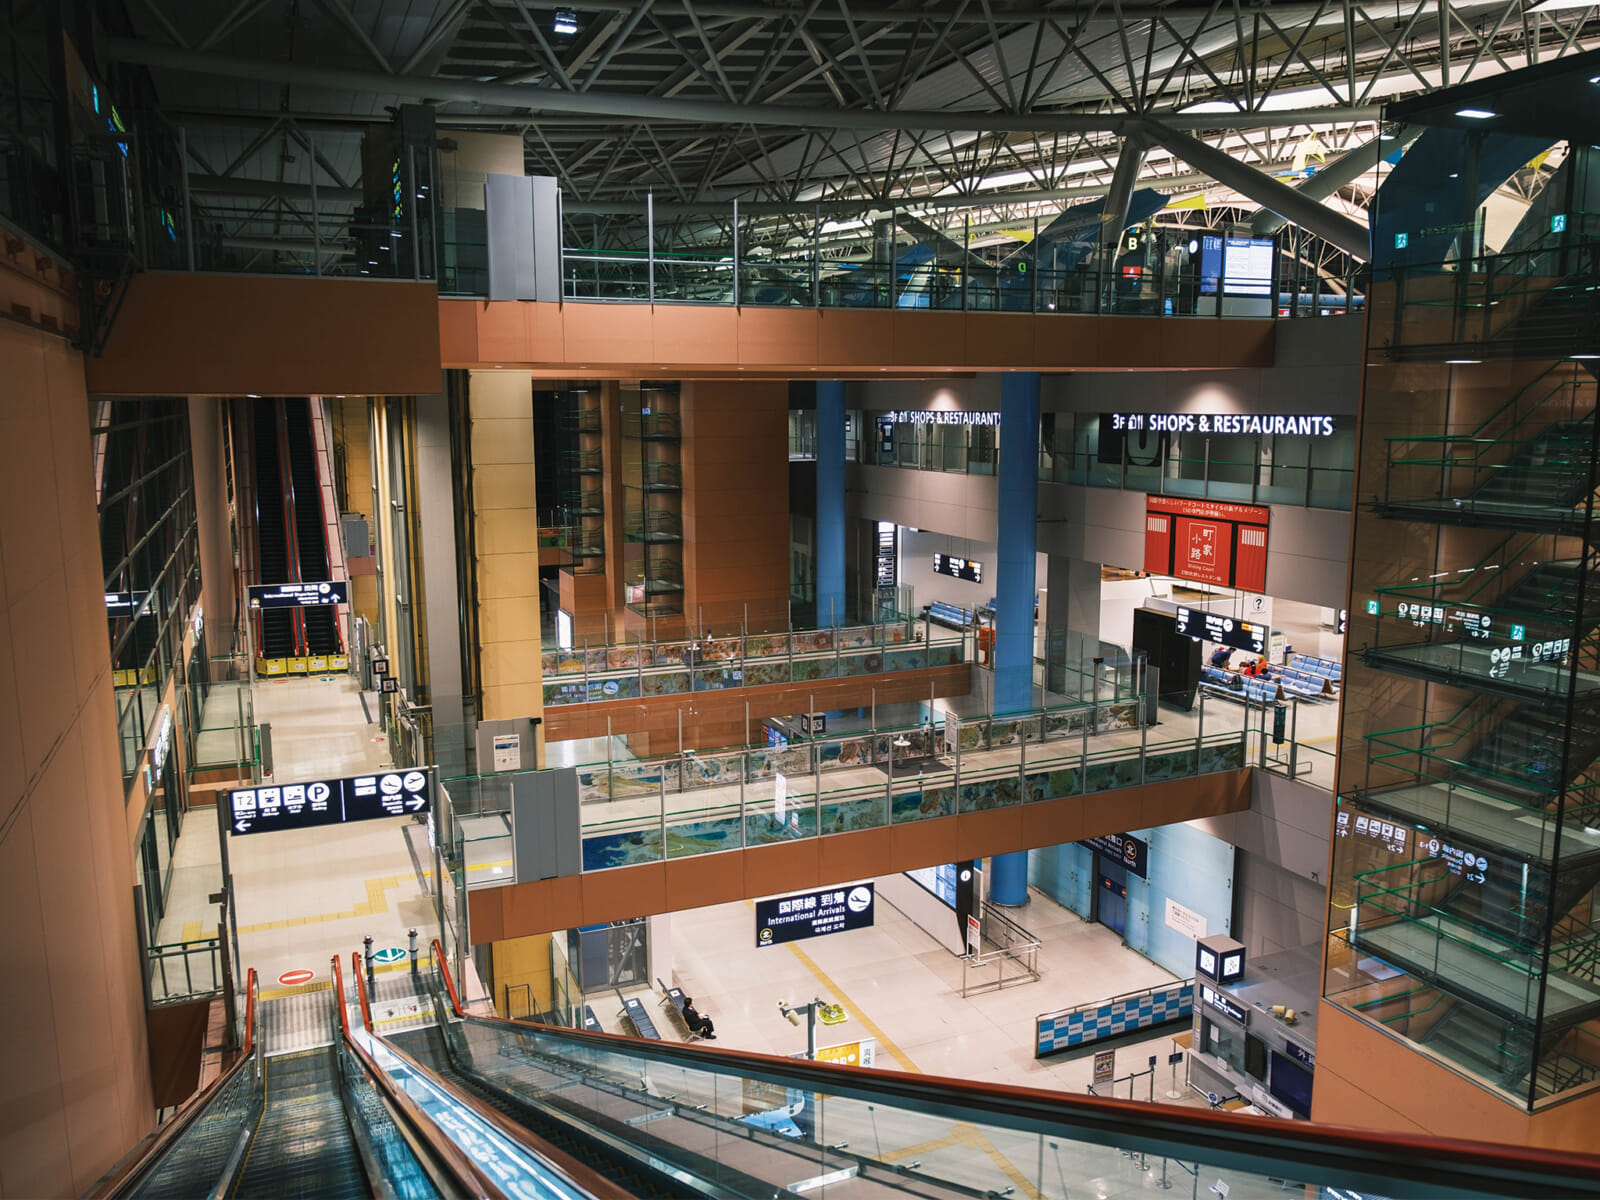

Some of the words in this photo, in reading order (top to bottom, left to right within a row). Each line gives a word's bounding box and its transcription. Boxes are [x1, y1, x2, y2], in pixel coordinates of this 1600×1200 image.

[1128, 237, 1138, 250] B
[910, 411, 935, 424] SHOPS
[936, 412, 943, 424] &
[1112, 414, 1126, 429] 3F
[1149, 414, 1194, 431] SHOPS
[1198, 415, 1210, 432] &
[1213, 416, 1334, 436] RESTAURANTS
[314, 787, 324, 799] P
[768, 910, 816, 926] International
[817, 905, 846, 917] Arrivals
